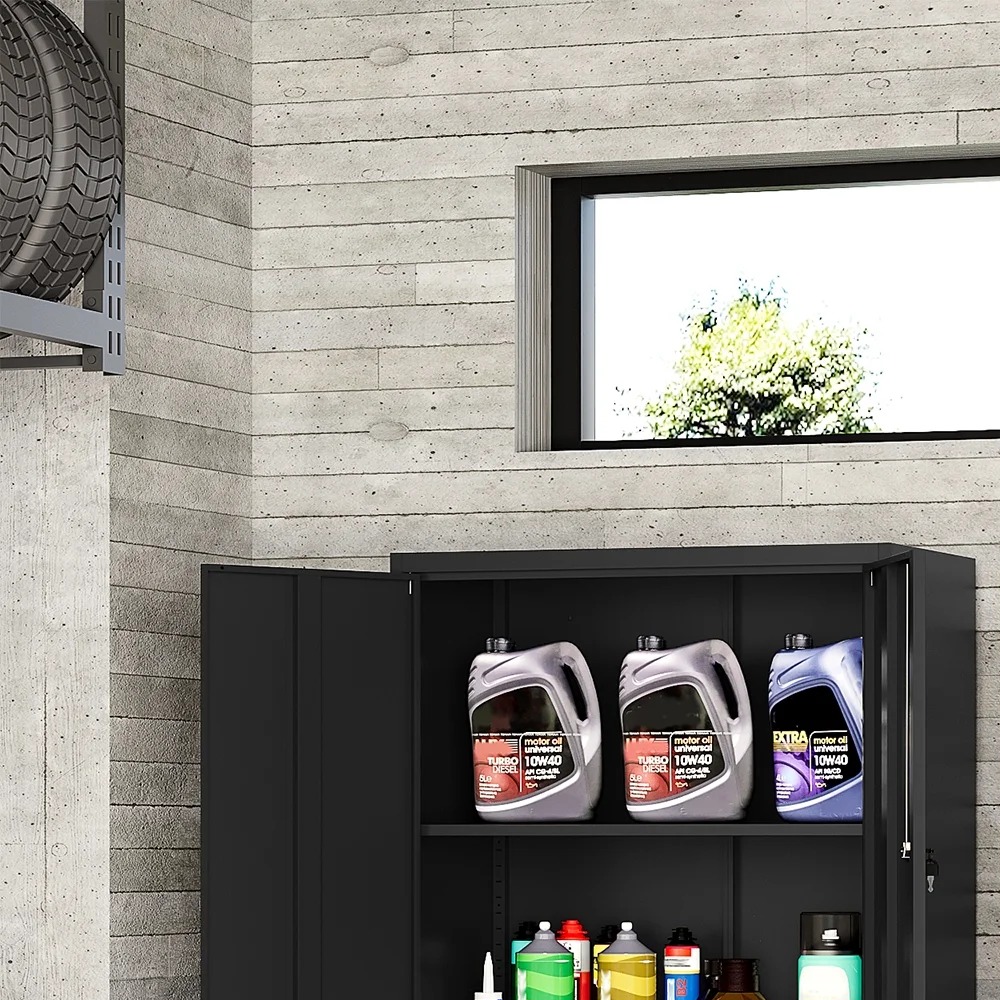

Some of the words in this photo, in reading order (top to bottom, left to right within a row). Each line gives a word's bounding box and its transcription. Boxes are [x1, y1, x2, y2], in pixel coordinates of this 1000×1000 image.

[551, 737, 562, 745] oil
[701, 736, 712, 744] oil
[773, 730, 808, 744] EXTRA
[837, 736, 848, 744] oil
[524, 745, 562, 753] universal
[674, 744, 712, 752] universal
[813, 744, 848, 752] universal
[487, 757, 519, 765] TURBO
[524, 755, 562, 766] 10W40
[637, 756, 669, 765] TURBO
[674, 754, 712, 766] 10W40
[813, 754, 848, 766] 10W40
[492, 766, 518, 774] DIESEL
[642, 764, 668, 773] DIESEL
[676, 978, 687, 996] B2
